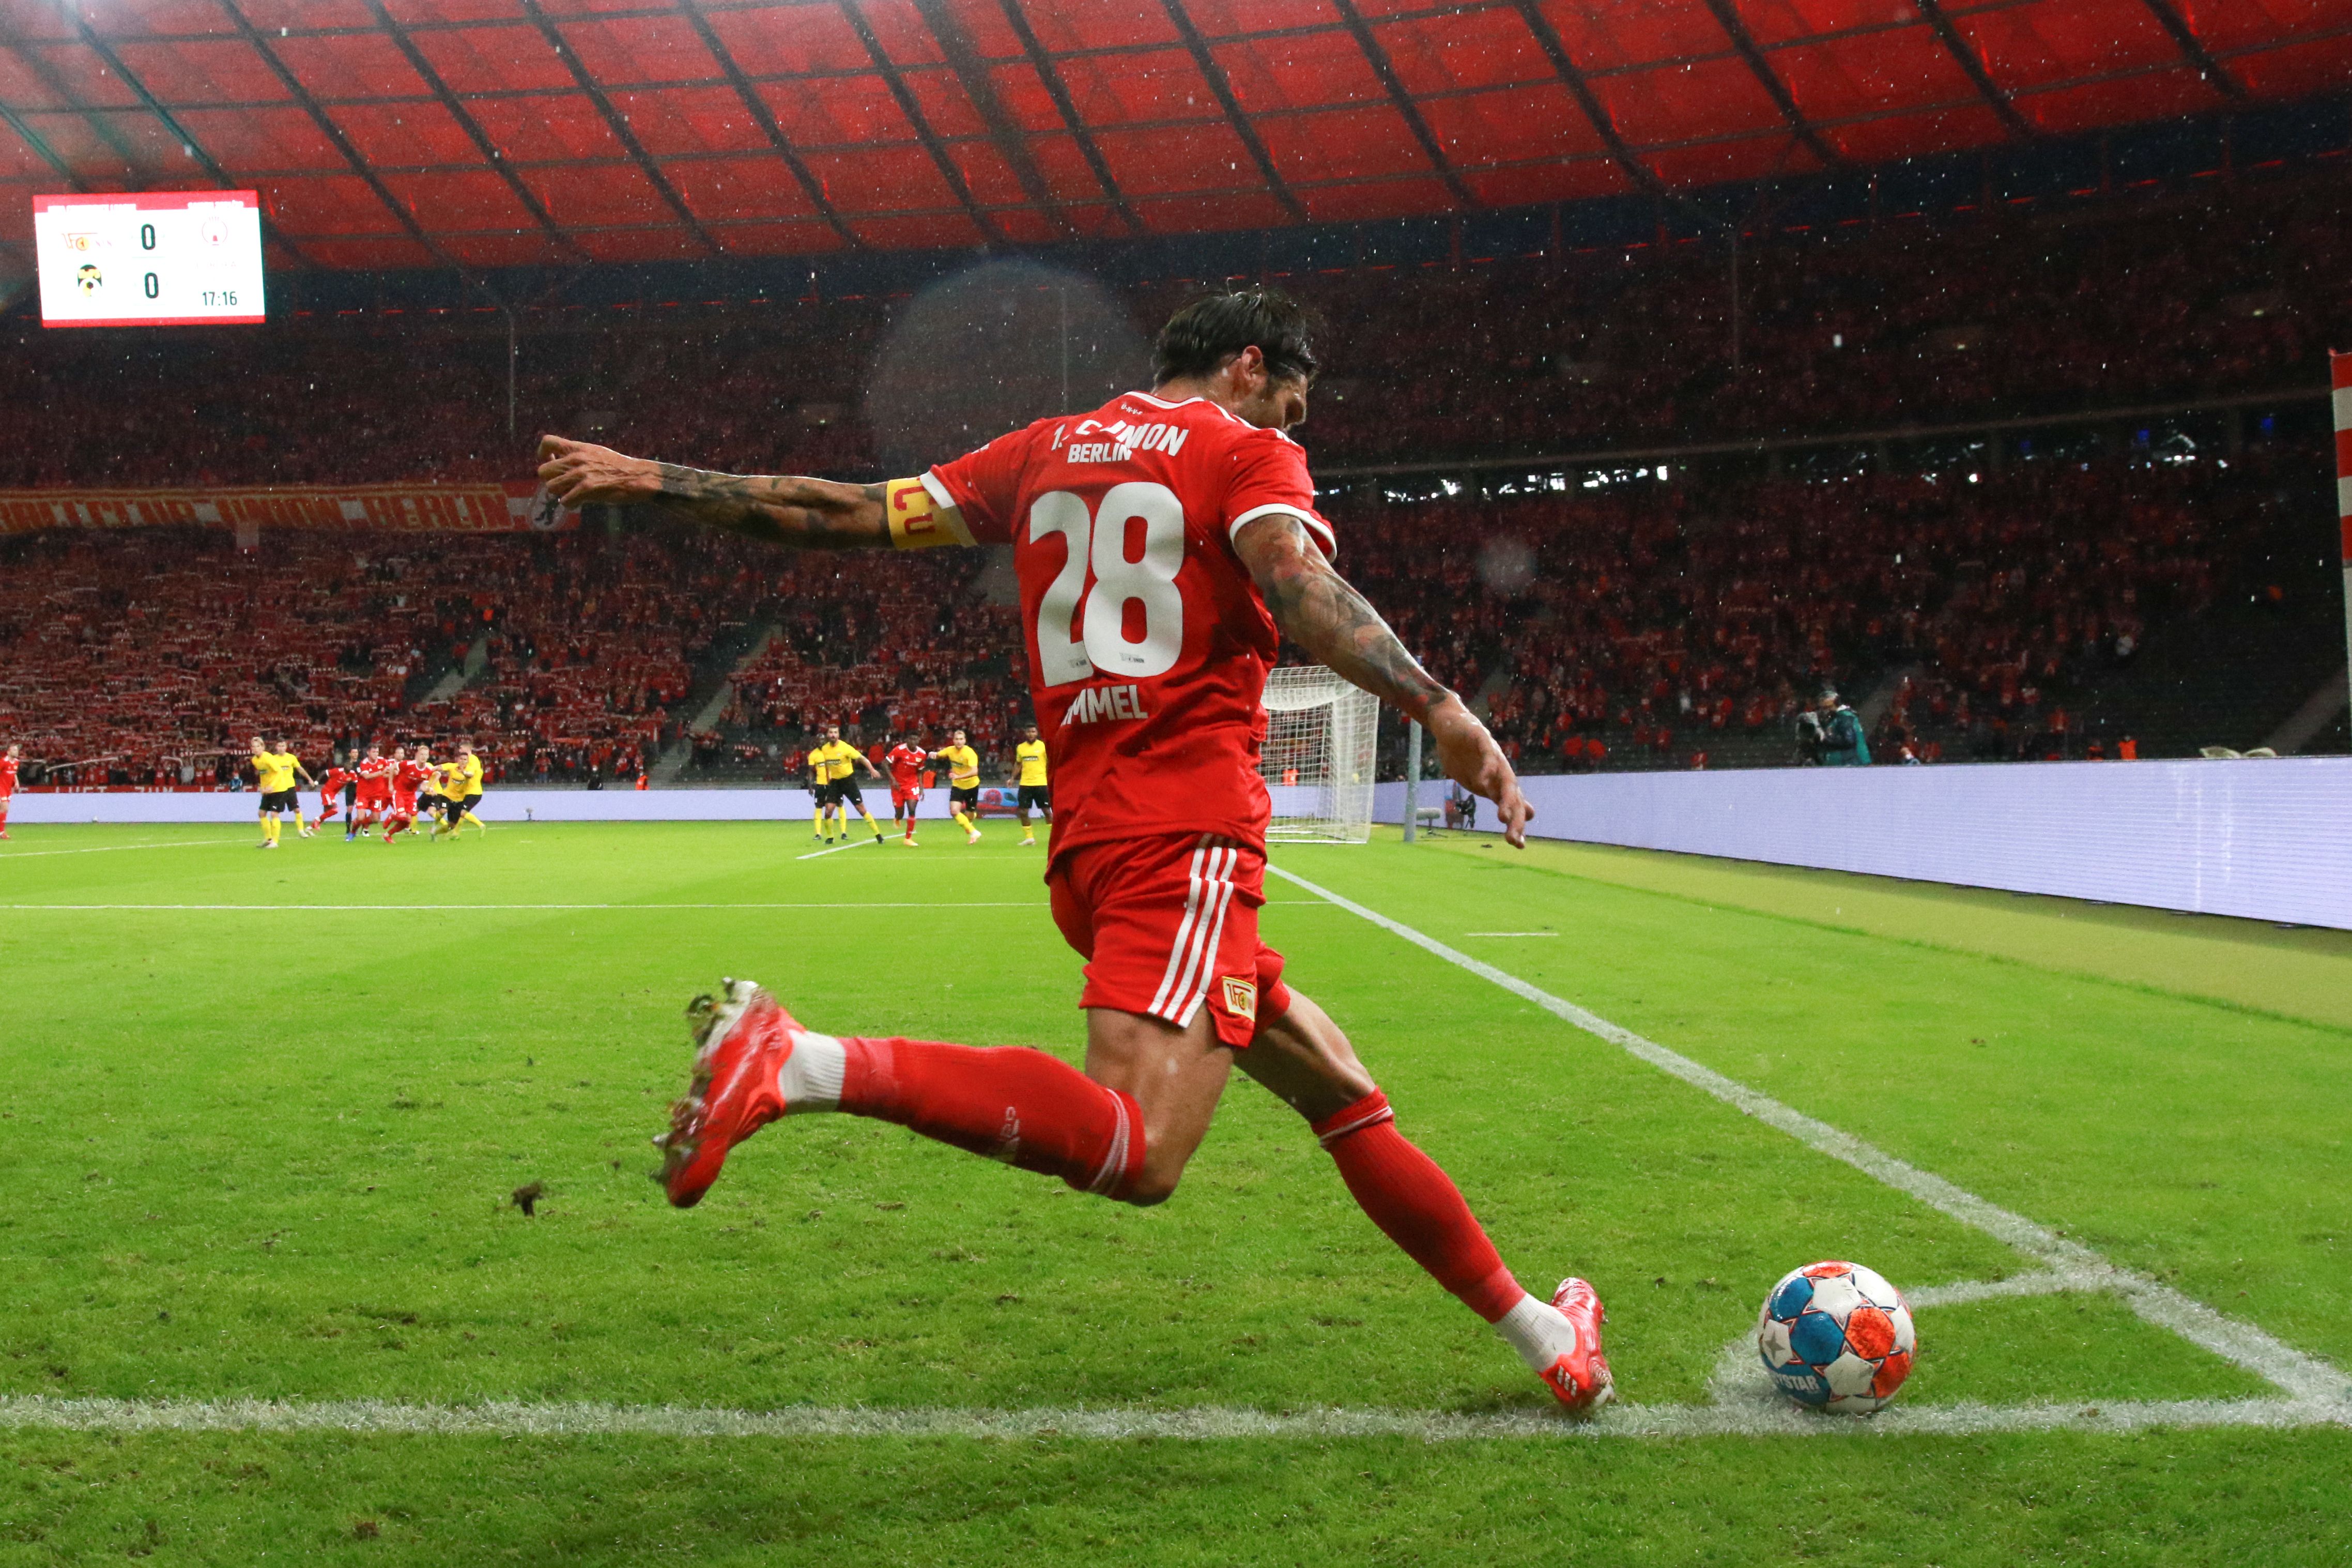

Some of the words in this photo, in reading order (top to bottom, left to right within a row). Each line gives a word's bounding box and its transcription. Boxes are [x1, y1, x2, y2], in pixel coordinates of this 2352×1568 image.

[141, 224, 155, 250] 0
[144, 273, 159, 299] 0
[203, 291, 237, 306] 17:16
[1067, 443, 1132, 463] BERLIN
[1029, 482, 1184, 687] 28
[1060, 684, 1149, 727] MMEL
[1776, 1374, 1820, 1390] YSTAR
